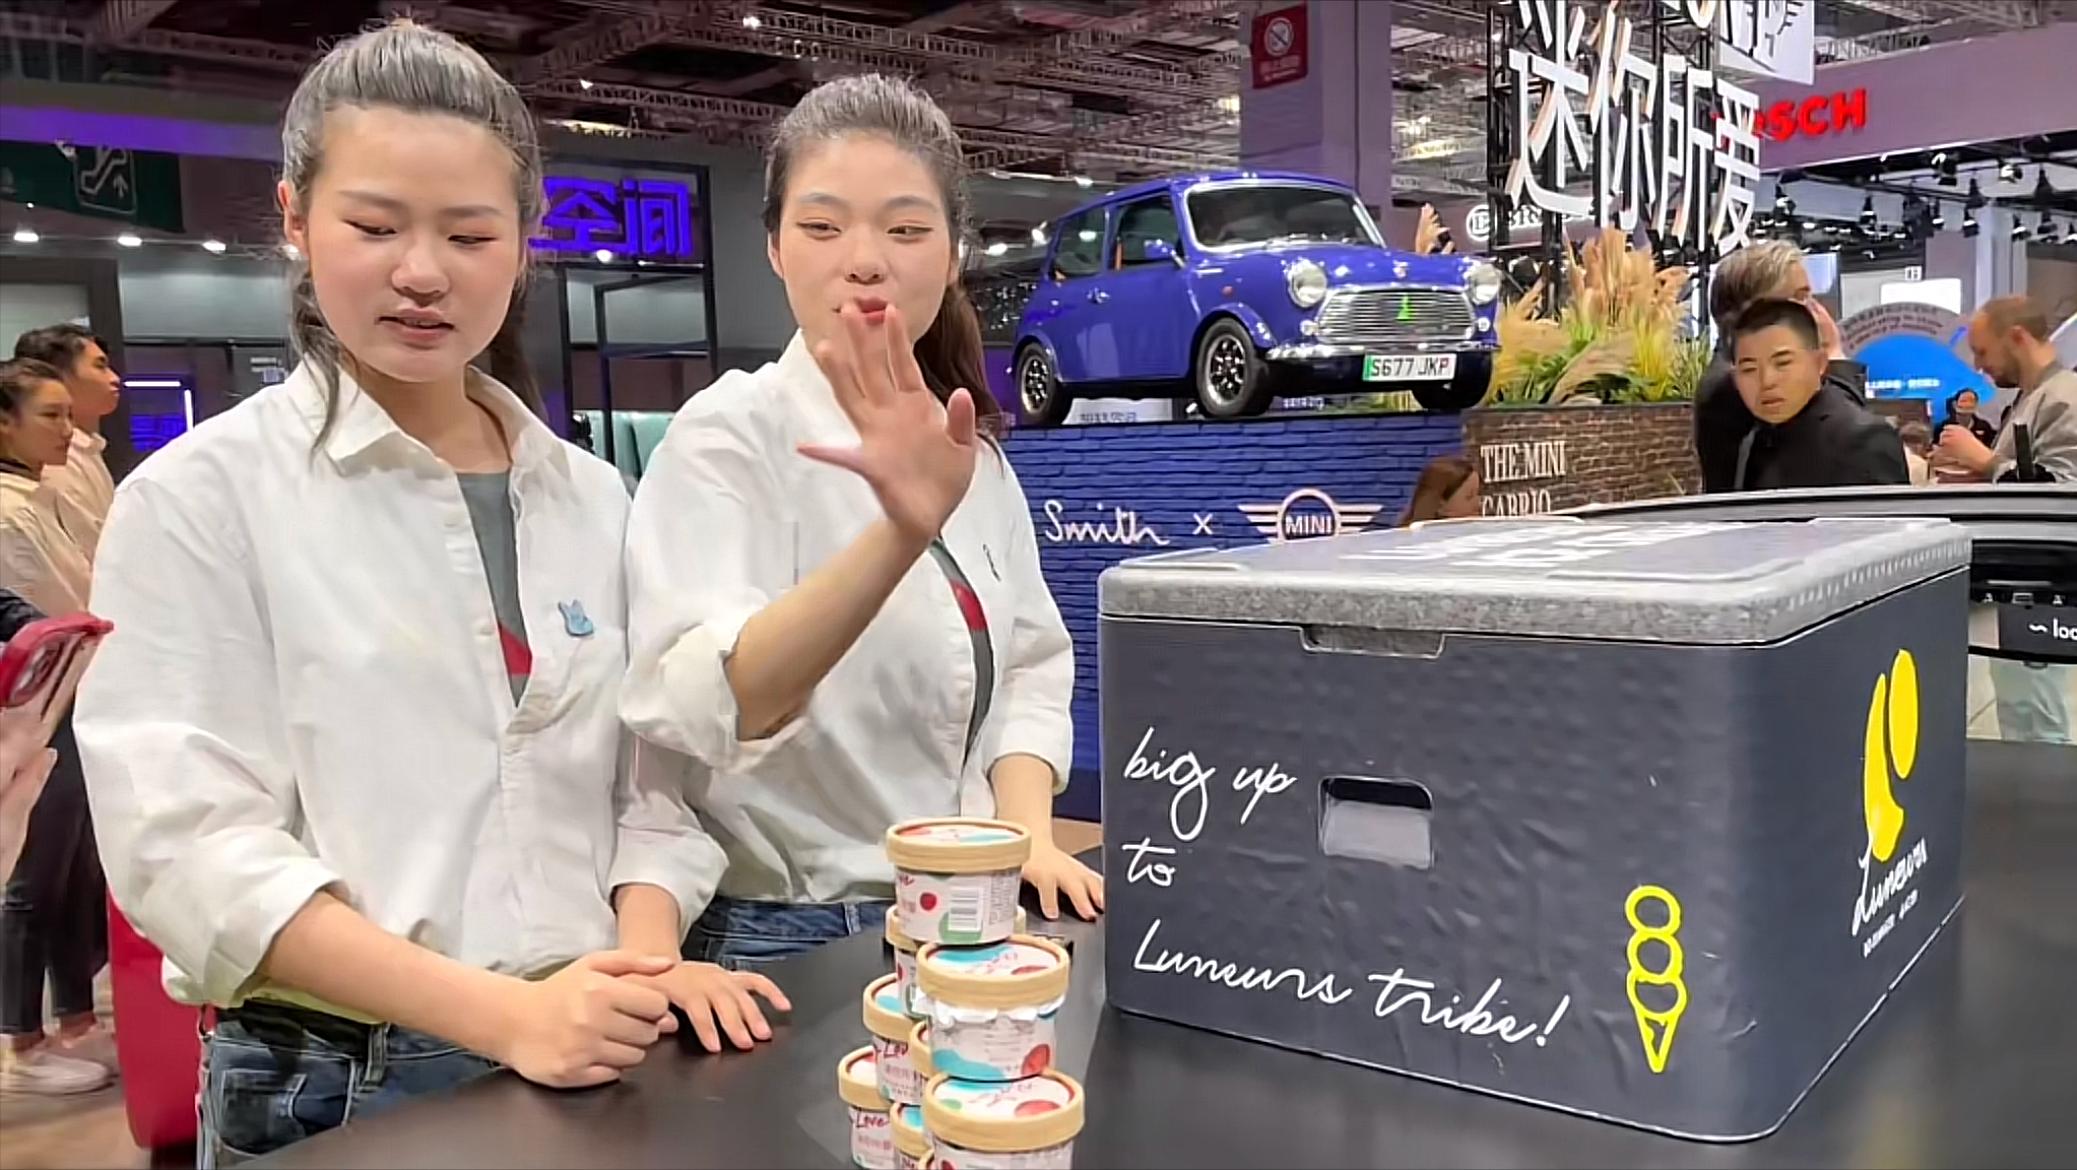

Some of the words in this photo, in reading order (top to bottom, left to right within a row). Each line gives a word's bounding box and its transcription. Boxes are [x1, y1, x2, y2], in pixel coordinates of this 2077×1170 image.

[1505, 0, 1760, 257] 迷你所爱
[1711, 88, 1867, 150] SCH
[528, 176, 693, 257] 空间
[1371, 357, 1415, 377] S677
[1481, 443, 1521, 484] THE
[1522, 440, 1567, 479] MINI
[1044, 499, 1170, 545] Smith
[1285, 514, 1333, 535] MINI
[1123, 727, 1215, 841] big
[1233, 763, 1297, 824] up
[1122, 838, 1176, 887] to
[1368, 967, 1570, 1047] tribe!
